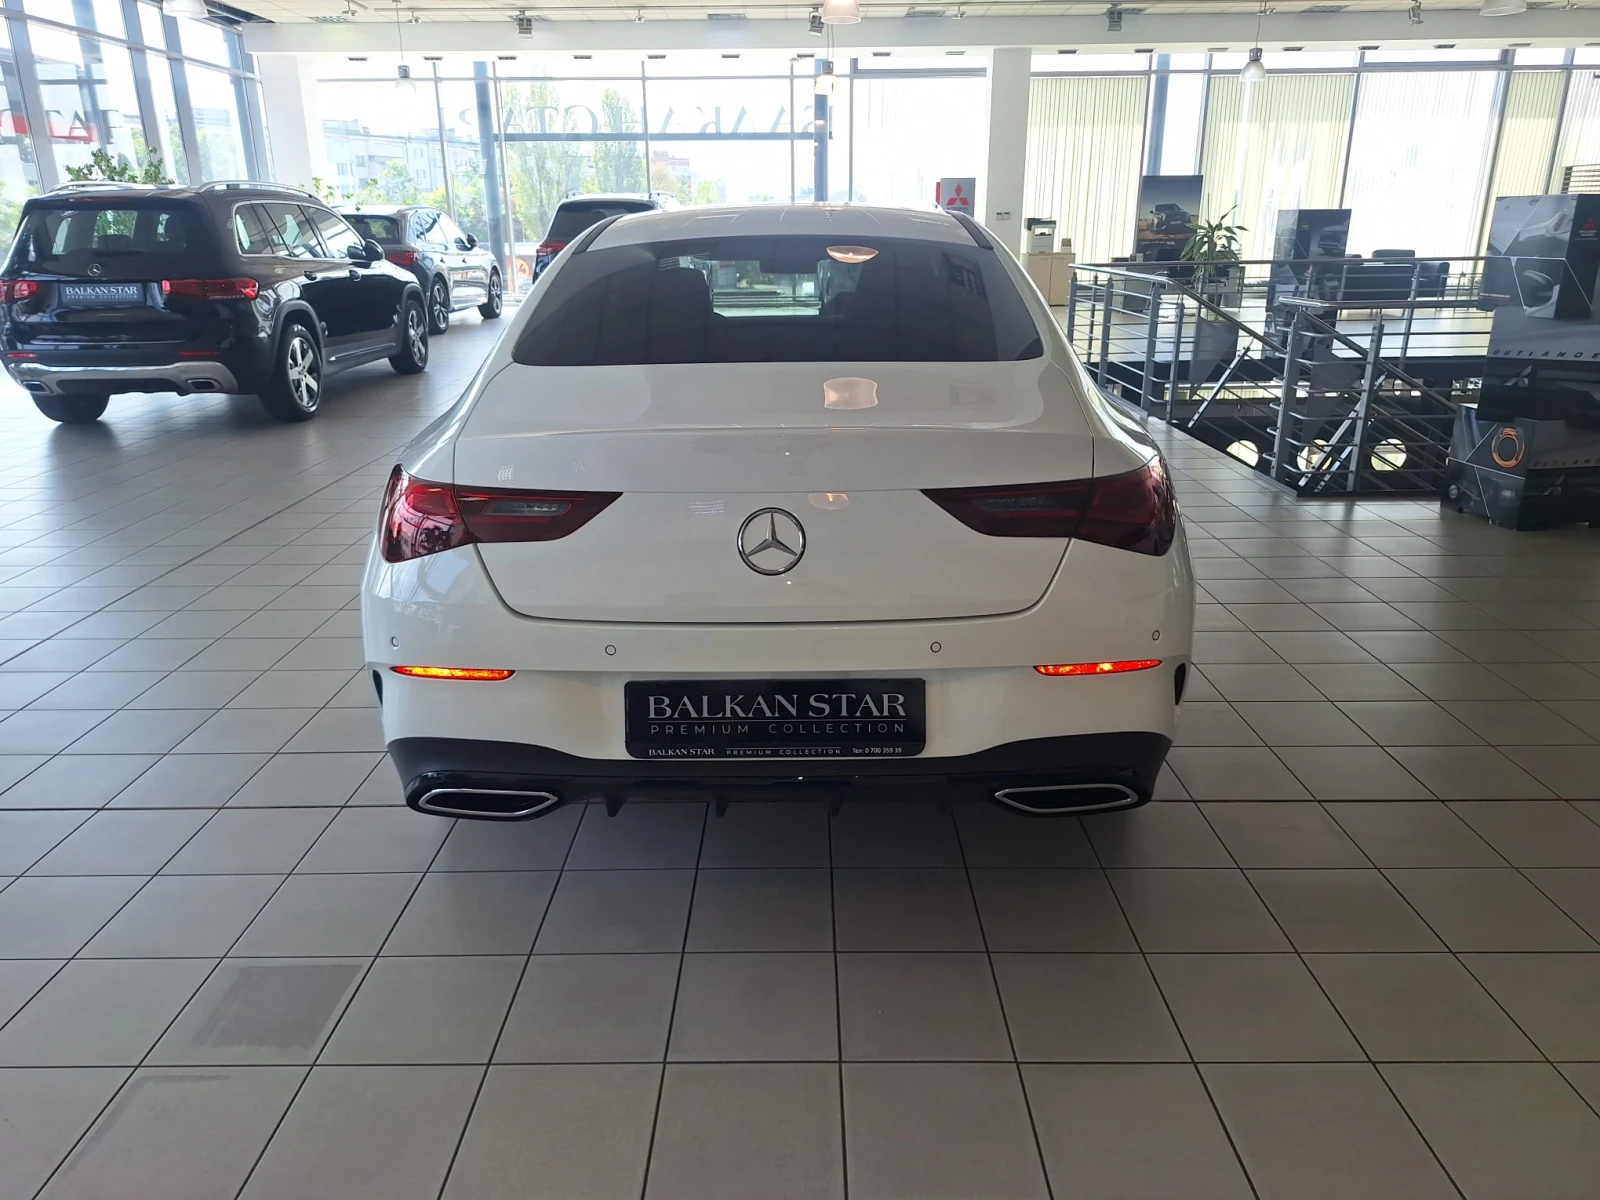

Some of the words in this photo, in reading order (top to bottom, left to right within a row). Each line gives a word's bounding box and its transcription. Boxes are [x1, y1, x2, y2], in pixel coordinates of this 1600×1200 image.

[65, 286, 108, 294] BALKAN
[109, 286, 138, 294] STAR
[647, 694, 799, 719] BALKAN
[808, 693, 906, 717] STAR
[651, 724, 749, 735] PREMIUM
[768, 723, 905, 734] COLLECTION
[648, 748, 688, 756] BALKAN
[689, 748, 715, 756] STAR
